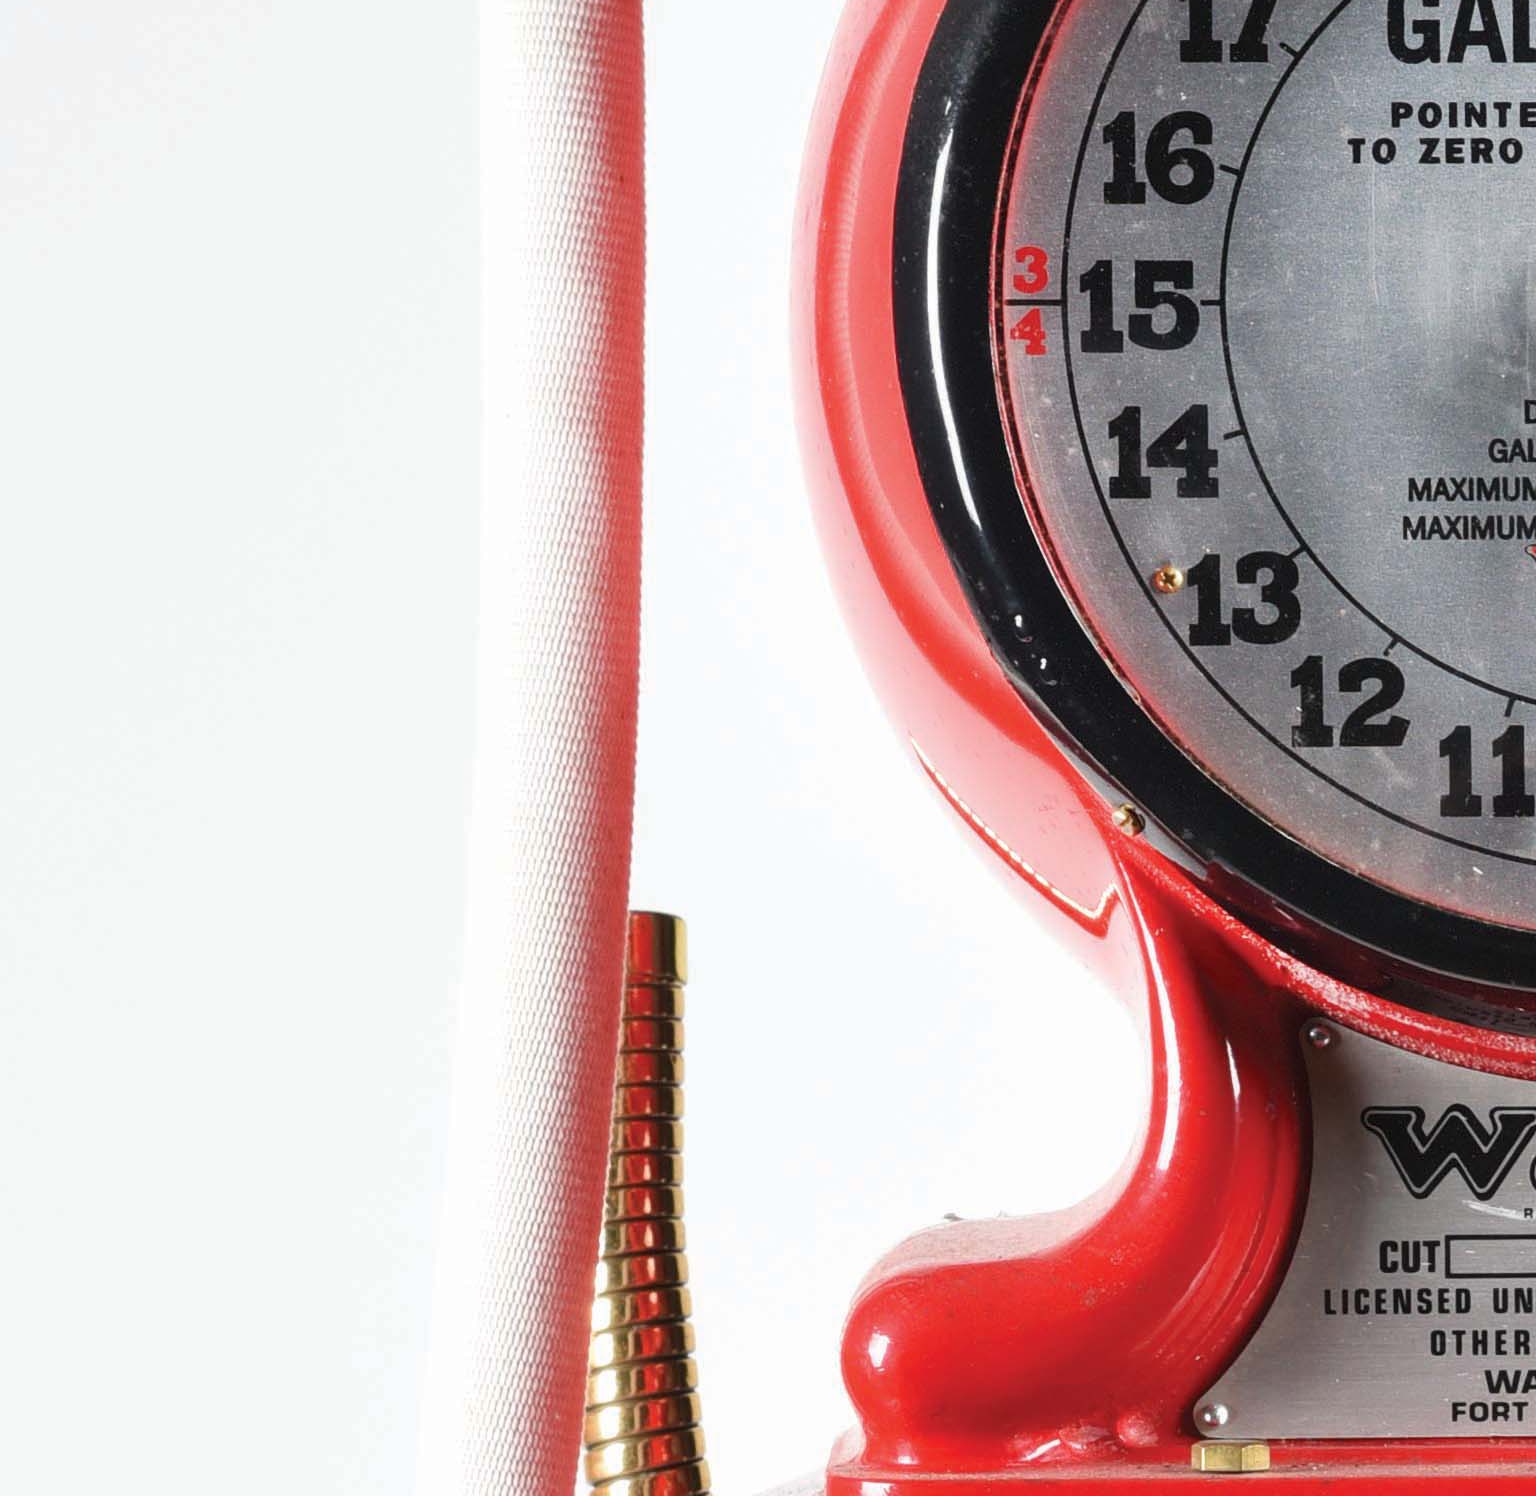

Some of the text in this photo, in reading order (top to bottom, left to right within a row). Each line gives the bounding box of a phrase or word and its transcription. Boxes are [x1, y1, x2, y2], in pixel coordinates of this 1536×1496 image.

[1103, 111, 1214, 205] 16
[1348, 138, 1396, 165] TO
[1419, 138, 1523, 164] ZERO
[1012, 246, 1049, 295] 3
[1080, 260, 1200, 353] 15
[1010, 307, 1047, 356] 4
[1108, 404, 1219, 499] 14
[1187, 551, 1302, 646] 13
[1289, 655, 1411, 748] 12
[1439, 725, 1535, 818] 11
[1379, 1240, 1440, 1273] CUT
[1323, 1288, 1470, 1315] LICENSED
[1431, 1330, 1530, 1356] OTHER
[1452, 1402, 1528, 1422] FORT
